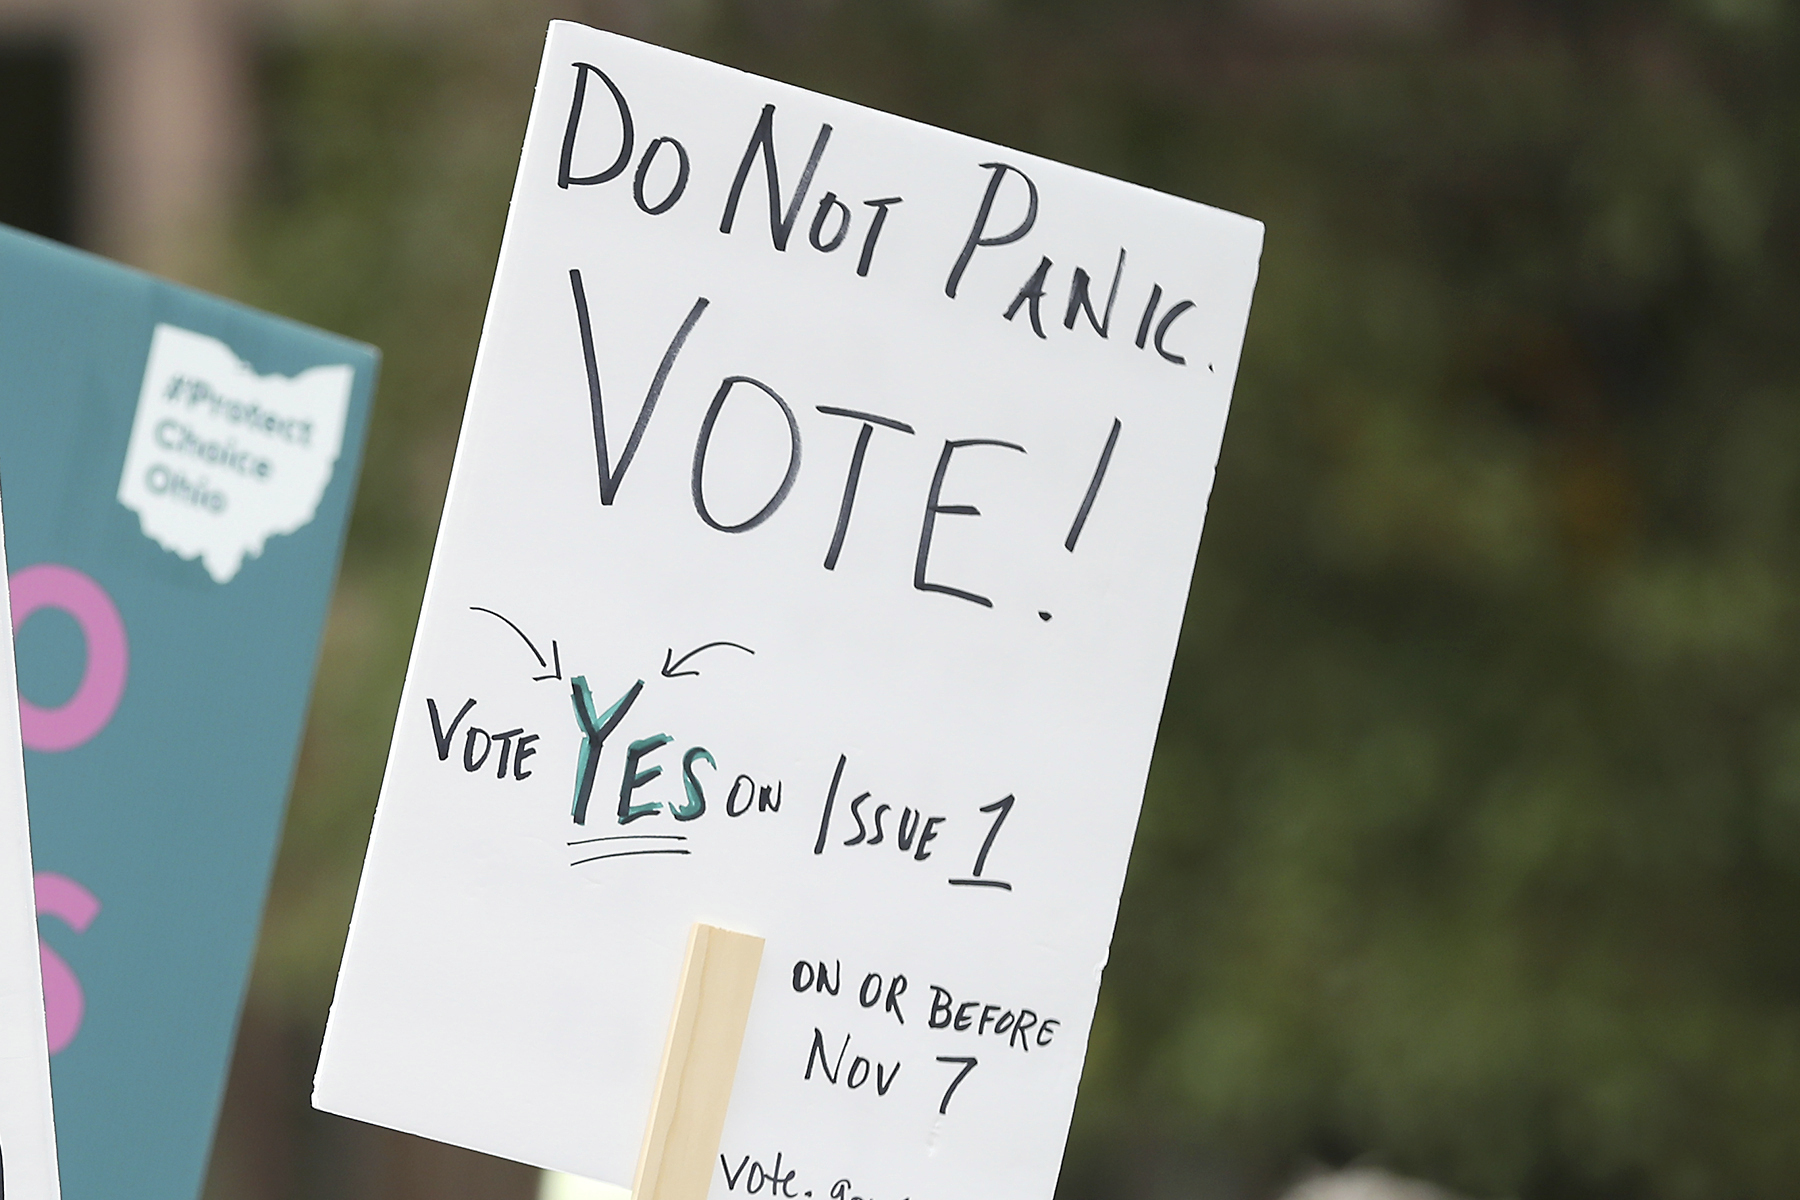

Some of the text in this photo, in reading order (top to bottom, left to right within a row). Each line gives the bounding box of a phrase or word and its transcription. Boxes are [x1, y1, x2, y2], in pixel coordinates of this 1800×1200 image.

[720, 104, 903, 278] NOT
[426, 698, 541, 780] VOTE
[570, 675, 717, 827] YES
[947, 794, 1017, 891] 1
[859, 972, 905, 1025] OR
[928, 985, 1061, 1052] BEFORE
[936, 1056, 979, 1115] 7
